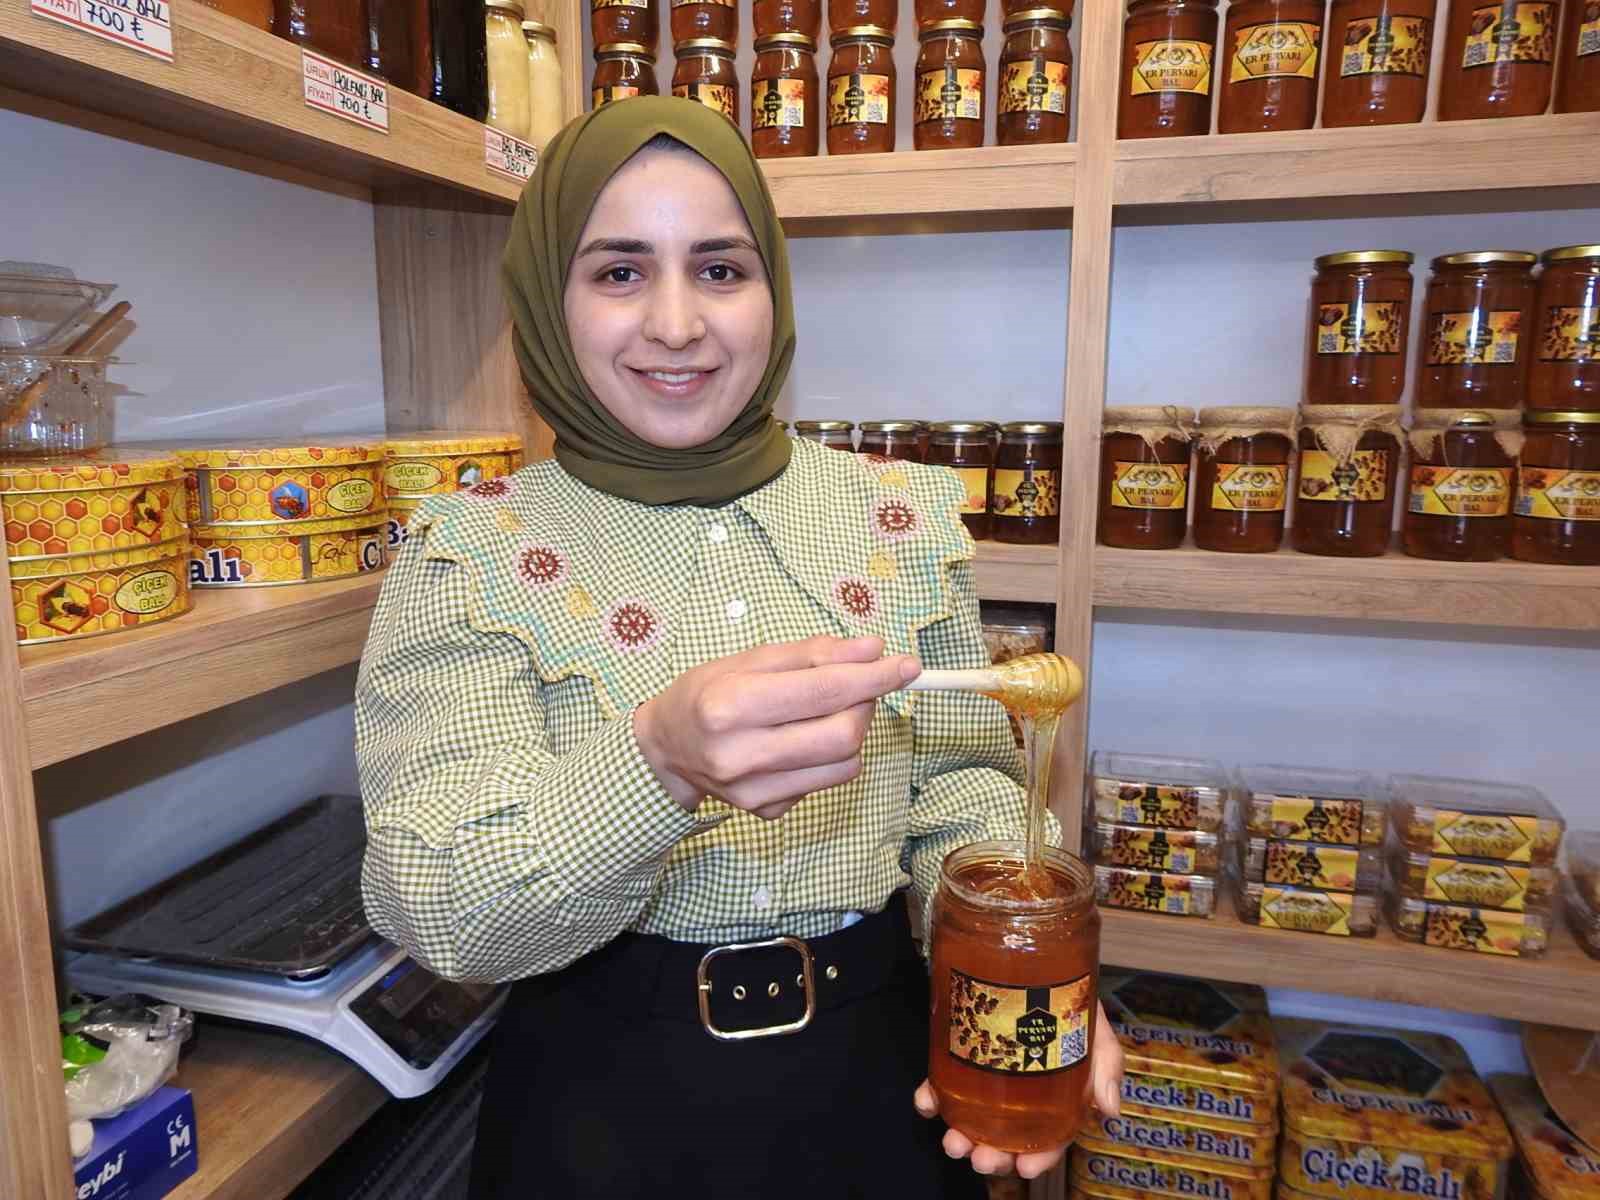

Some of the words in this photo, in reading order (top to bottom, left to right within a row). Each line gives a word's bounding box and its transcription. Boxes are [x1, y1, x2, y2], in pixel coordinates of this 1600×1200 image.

[84, 0, 124, 32] 700
[338, 91, 360, 114] 700
[191, 551, 242, 582] alı
[1122, 1074, 1185, 1107] içek
[1195, 1091, 1252, 1119] Balı
[1196, 1132, 1251, 1160] Balı
[77, 1152, 124, 1200] eybi
[1304, 1149, 1389, 1188] Çiçek
[1402, 1164, 1461, 1200] Balı
